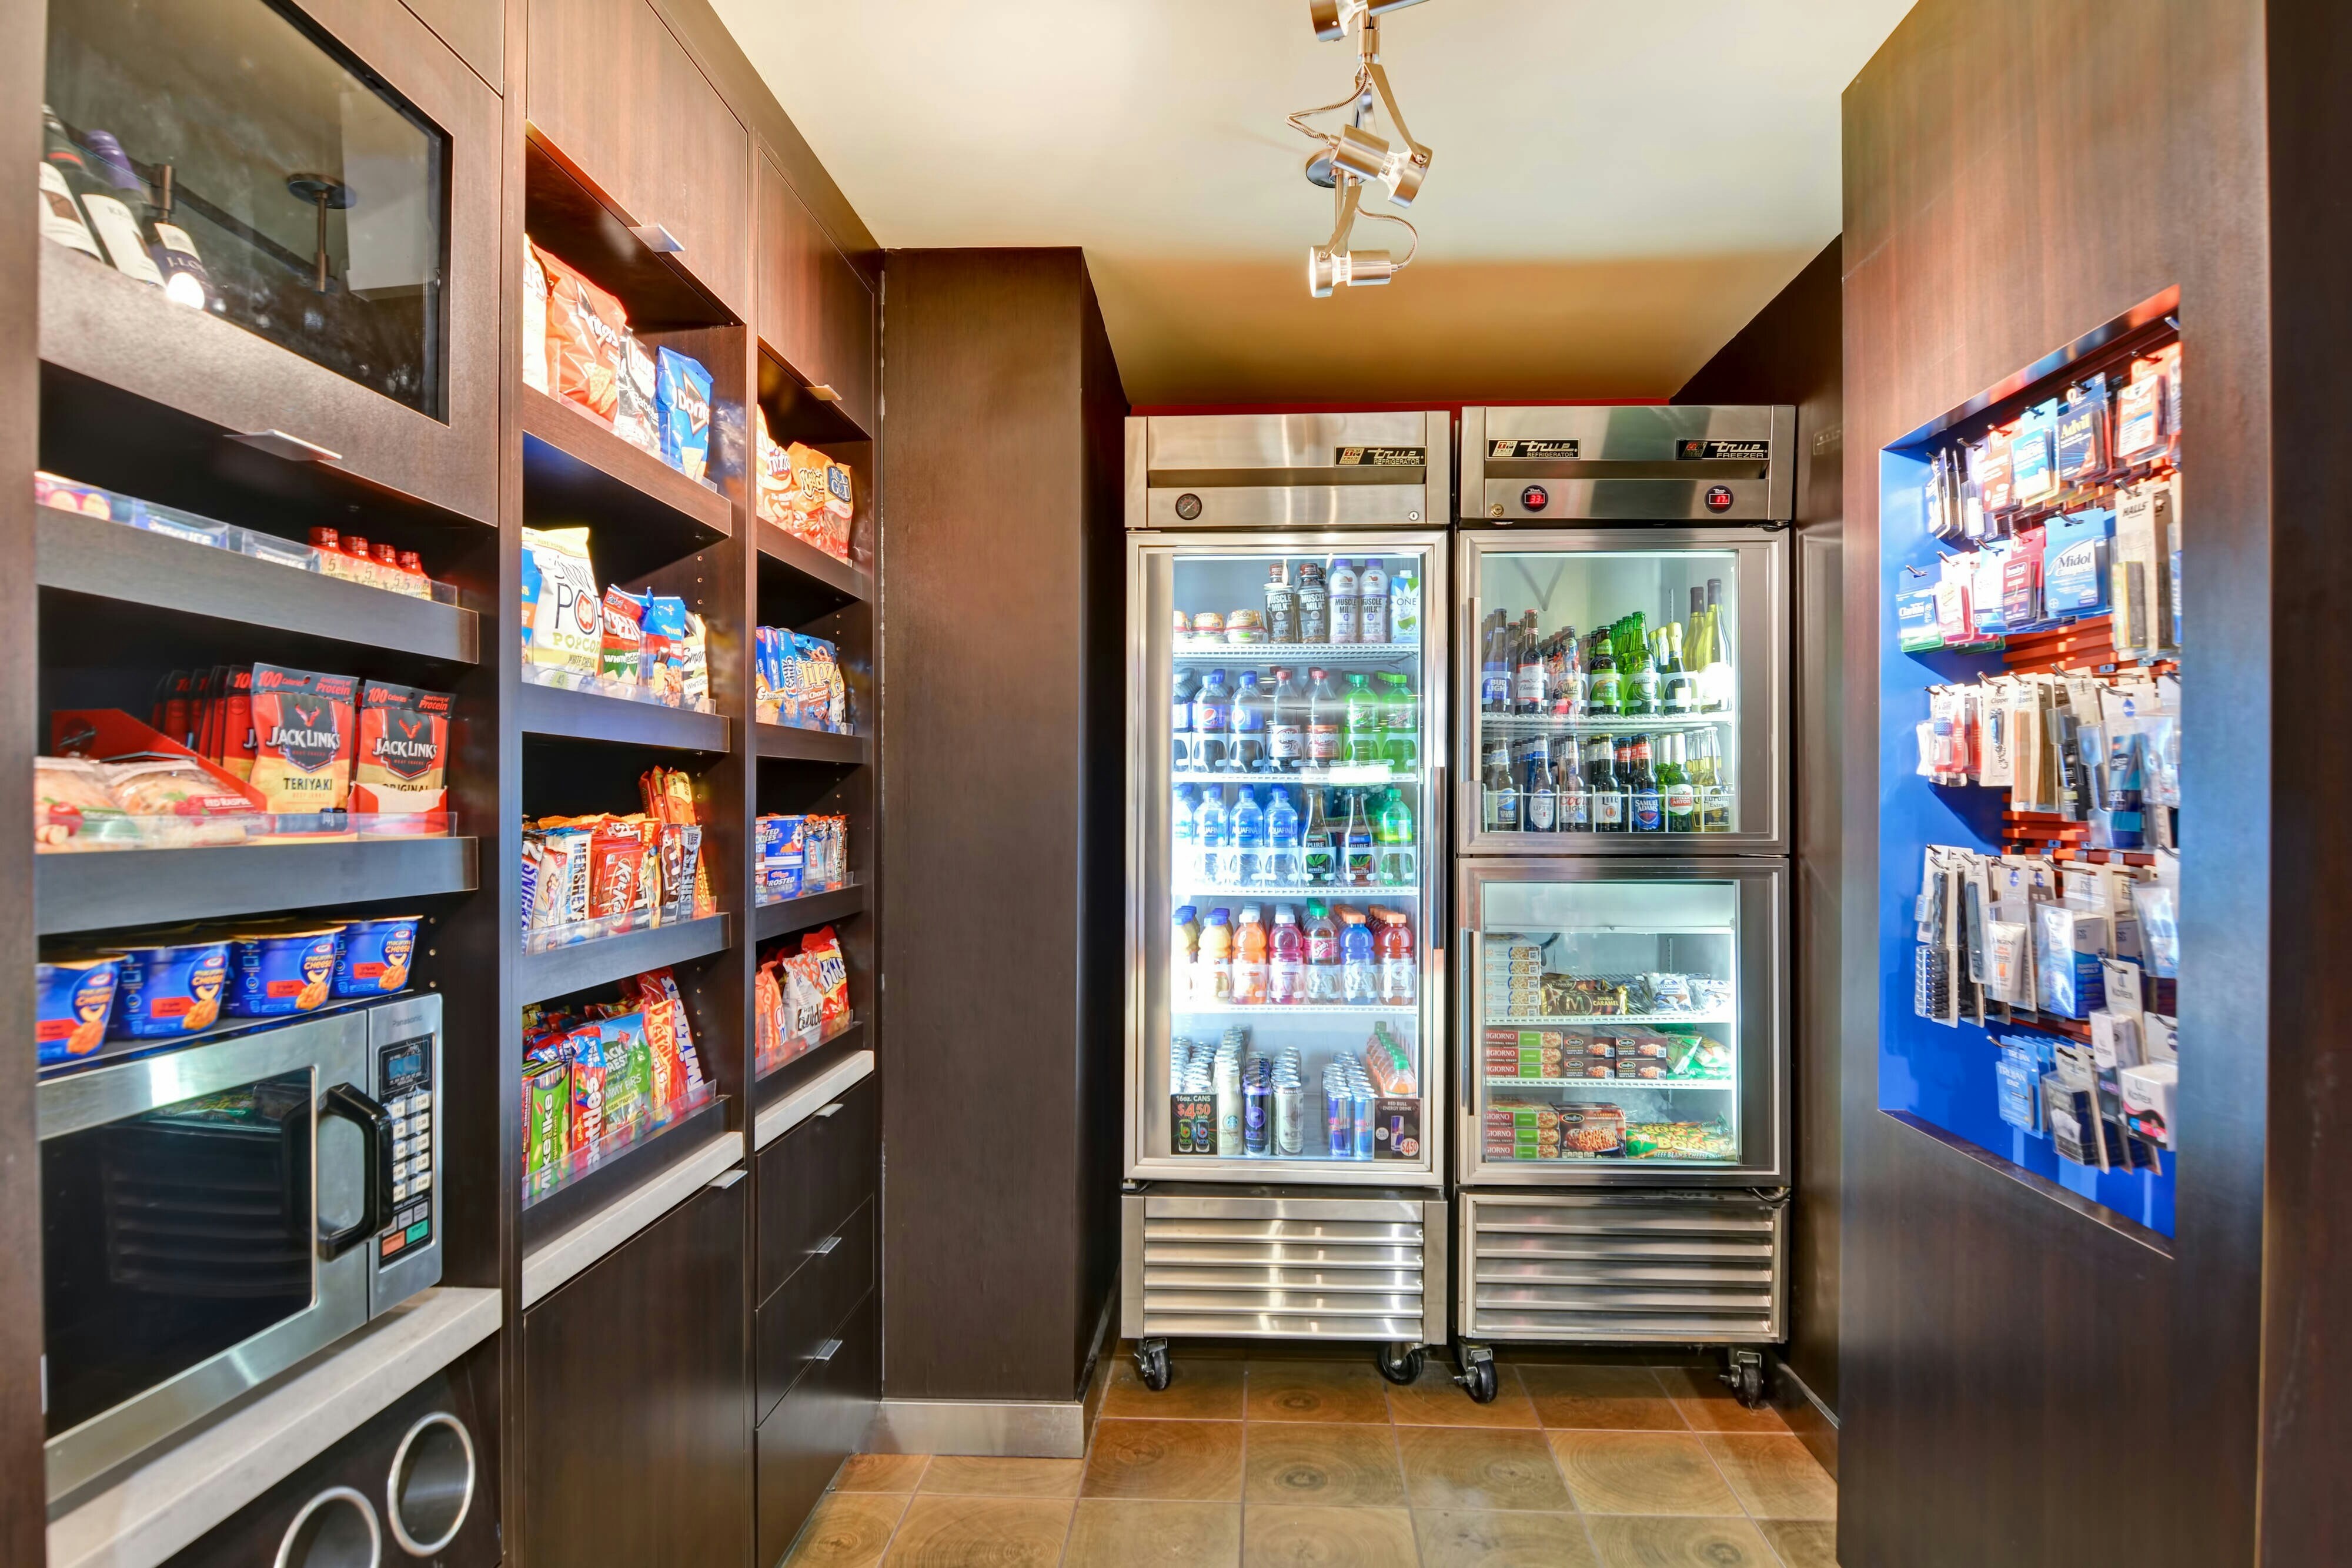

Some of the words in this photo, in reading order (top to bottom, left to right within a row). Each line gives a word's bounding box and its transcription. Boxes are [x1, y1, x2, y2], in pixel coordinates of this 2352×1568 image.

[2060, 413, 2091, 439] Advil
[2123, 502, 2149, 516] HALLS
[2059, 552, 2092, 569] Midol
[1271, 603, 1288, 611] MILK
[1306, 602, 1323, 611] MILK
[553, 632, 600, 654] POPCOR
[258, 670, 283, 688] 100
[316, 683, 351, 695] Protein
[368, 687, 388, 703] 100
[419, 700, 448, 710] Protein
[266, 726, 306, 748] JACK
[307, 729, 340, 750] LINK'S
[372, 737, 407, 758] JACK
[408, 741, 437, 759] LINK'S
[283, 778, 332, 790] TERIYAKI
[392, 1015, 423, 1027] Panasonic
